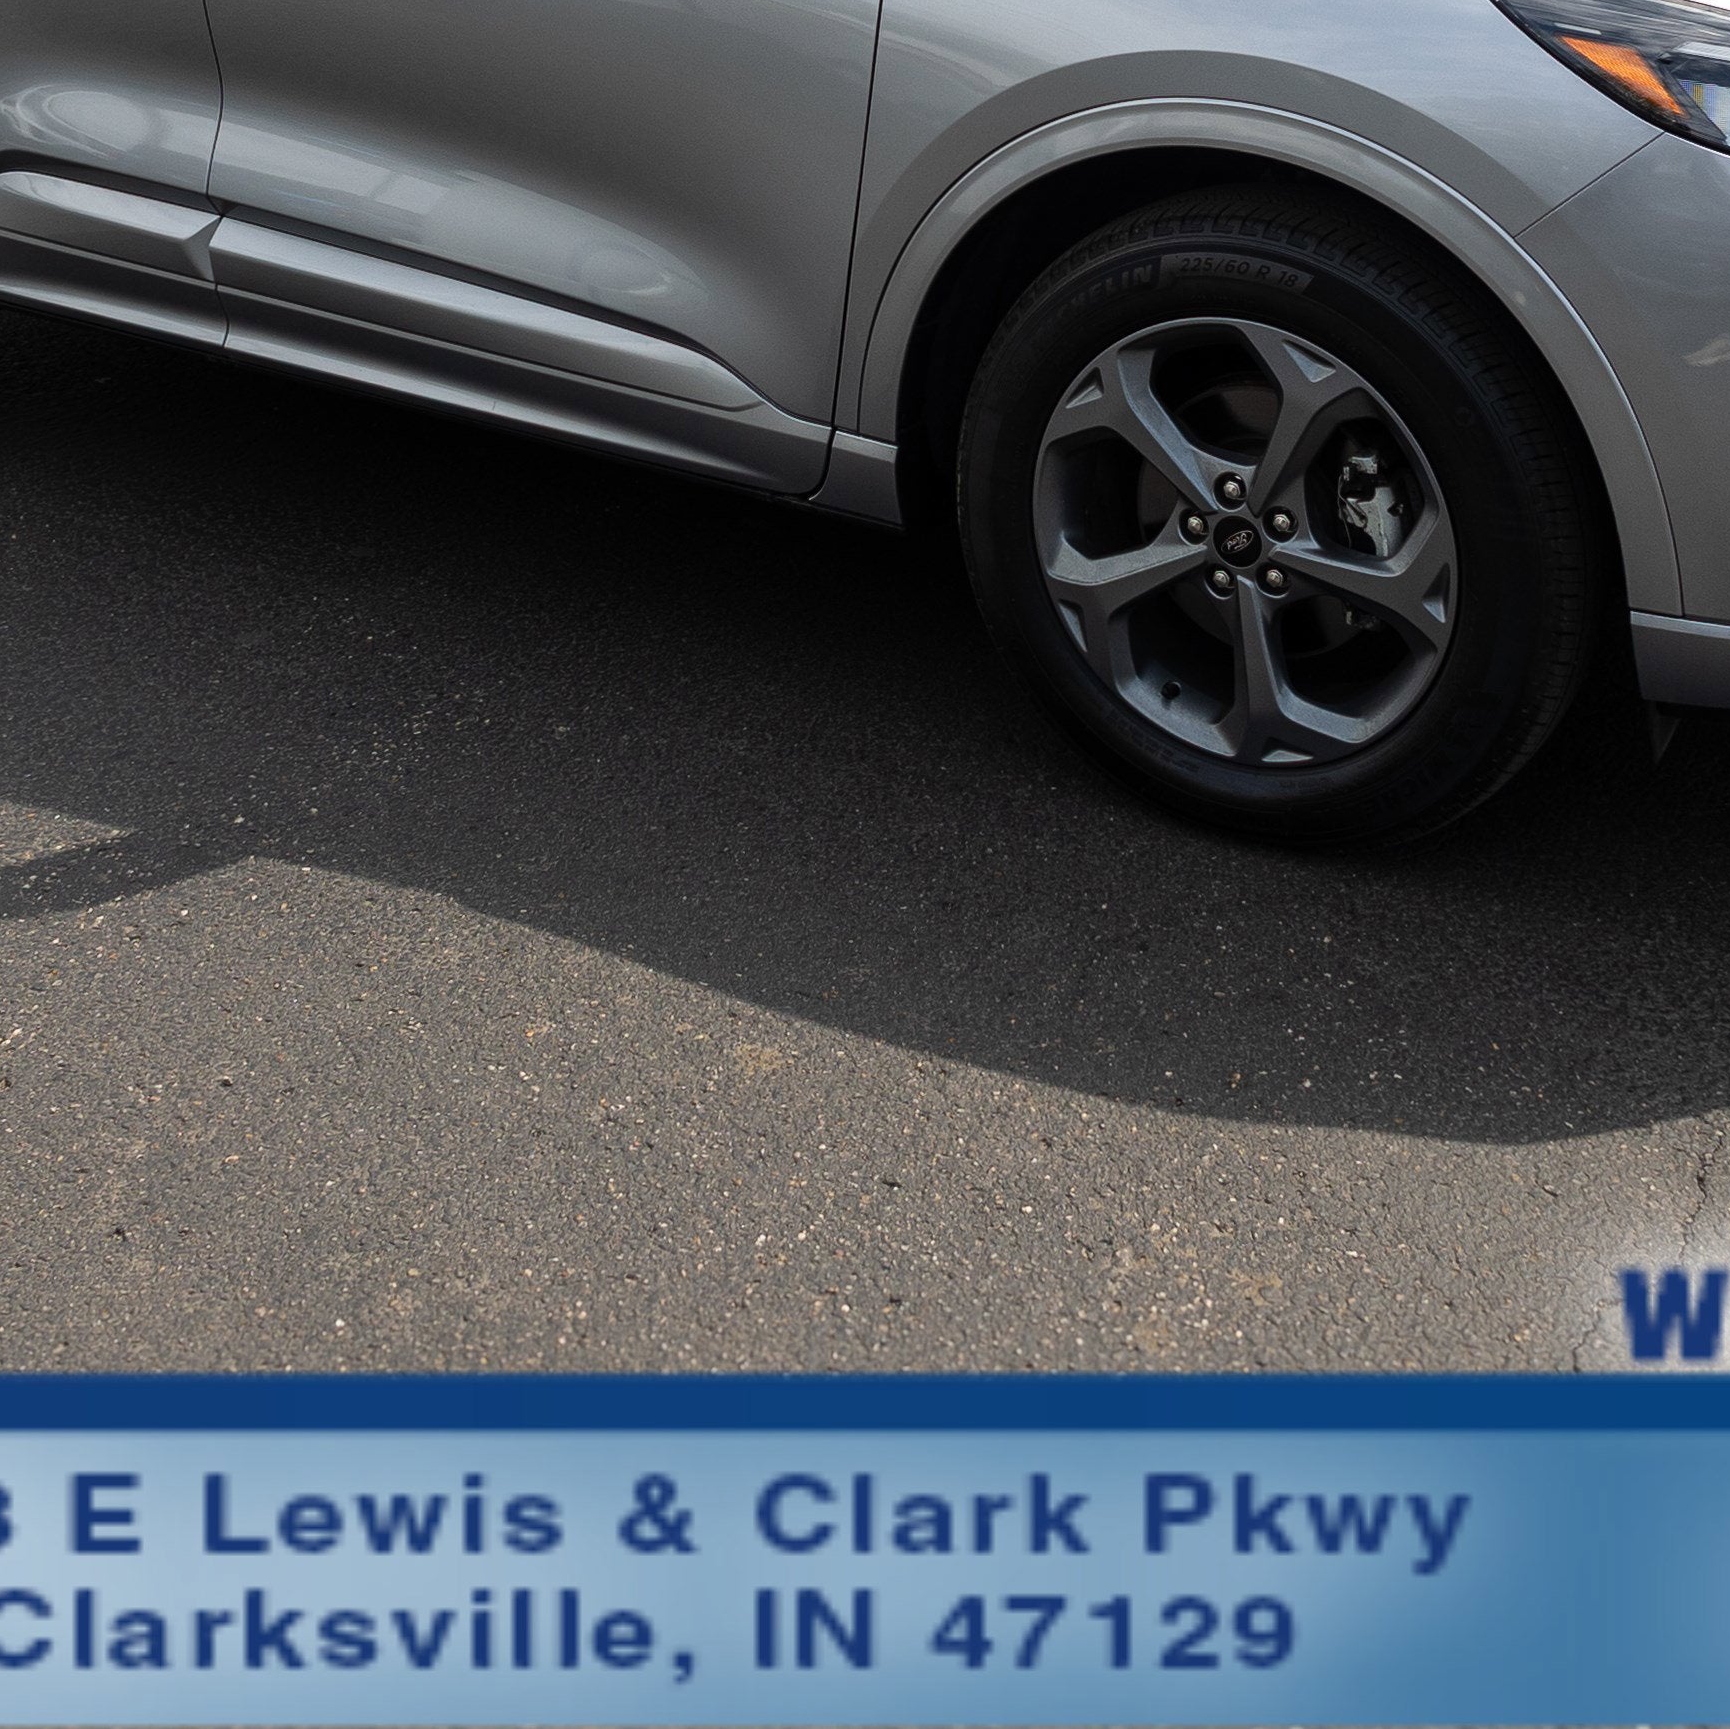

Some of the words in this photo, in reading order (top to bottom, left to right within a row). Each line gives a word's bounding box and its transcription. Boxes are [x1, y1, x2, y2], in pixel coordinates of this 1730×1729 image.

[1179, 257, 1250, 275] 225/60
[1256, 264, 1271, 280] R
[1277, 270, 1299, 288] 18
